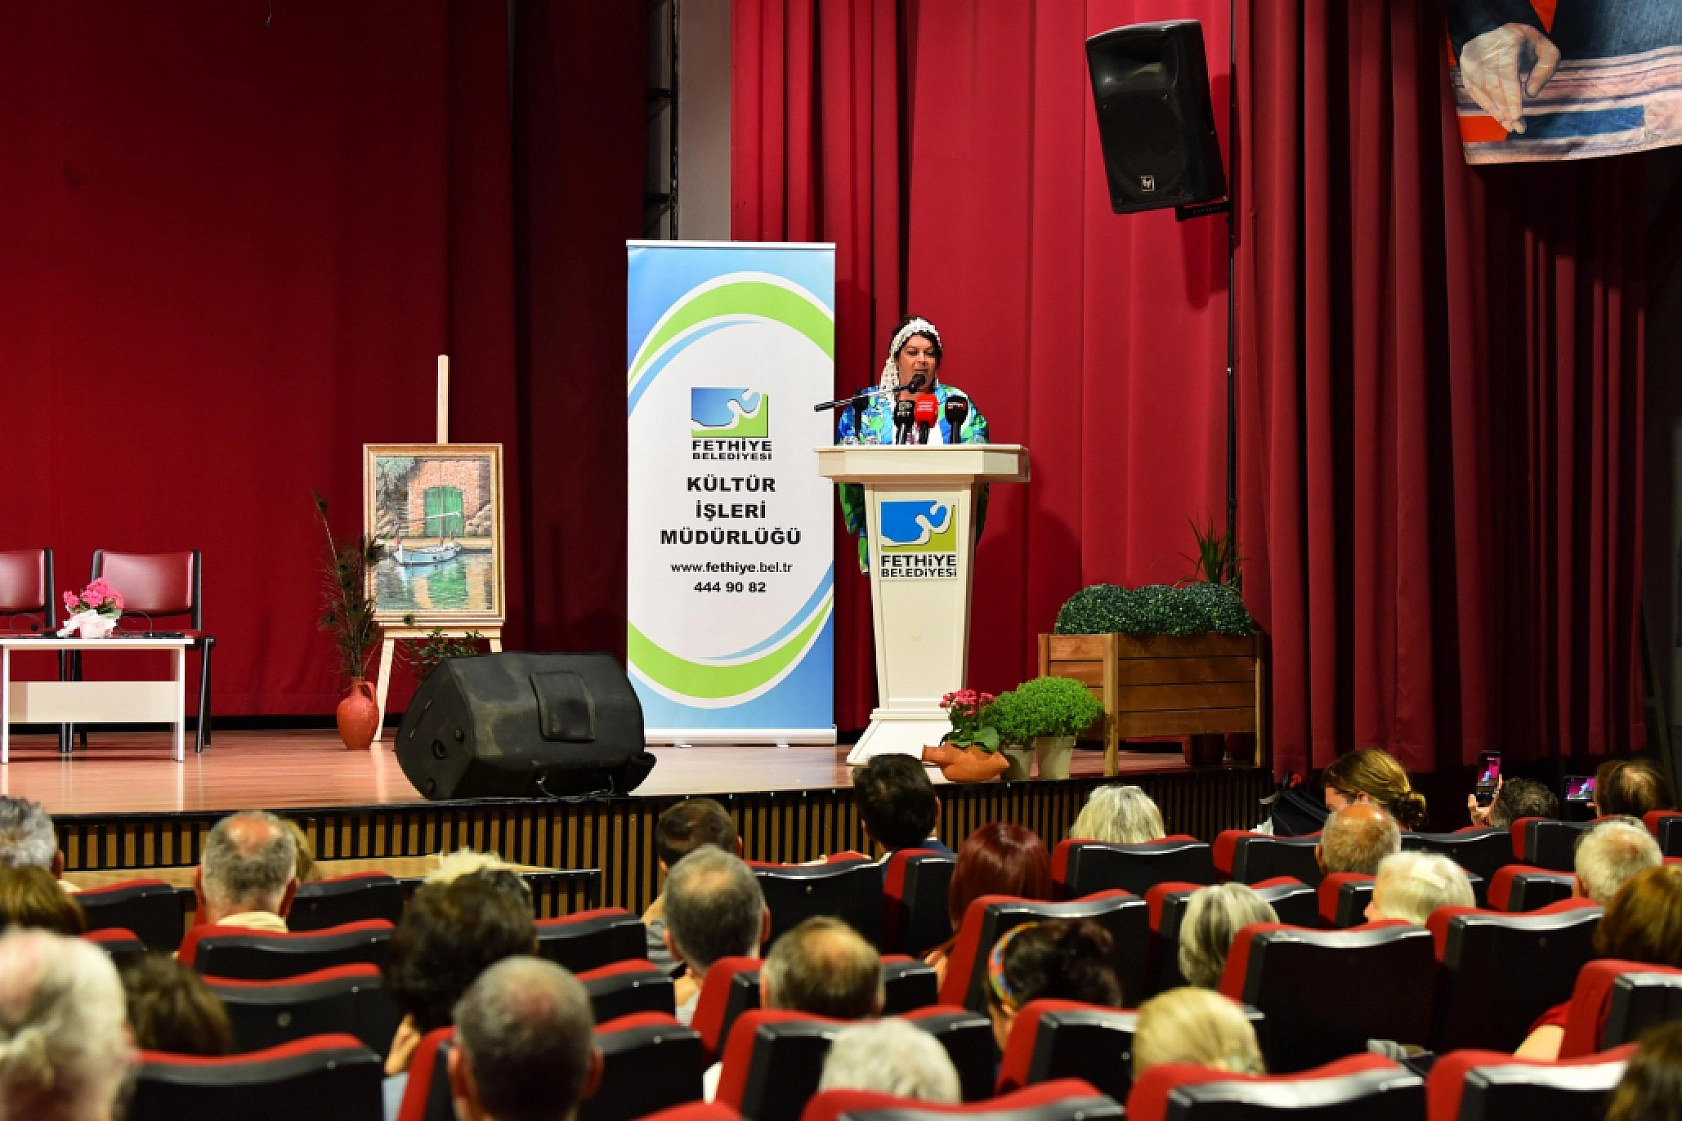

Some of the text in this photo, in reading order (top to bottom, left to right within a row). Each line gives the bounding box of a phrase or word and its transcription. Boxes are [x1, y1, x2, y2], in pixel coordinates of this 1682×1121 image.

[687, 474, 775, 492] KÜLTÜR
[696, 500, 766, 521] İŞLERİ
[660, 526, 801, 544] MÜDÜRLÜĞÜ
[670, 562, 793, 575] www.fethiye.bel.tr
[694, 582, 766, 593] 444 90 82
